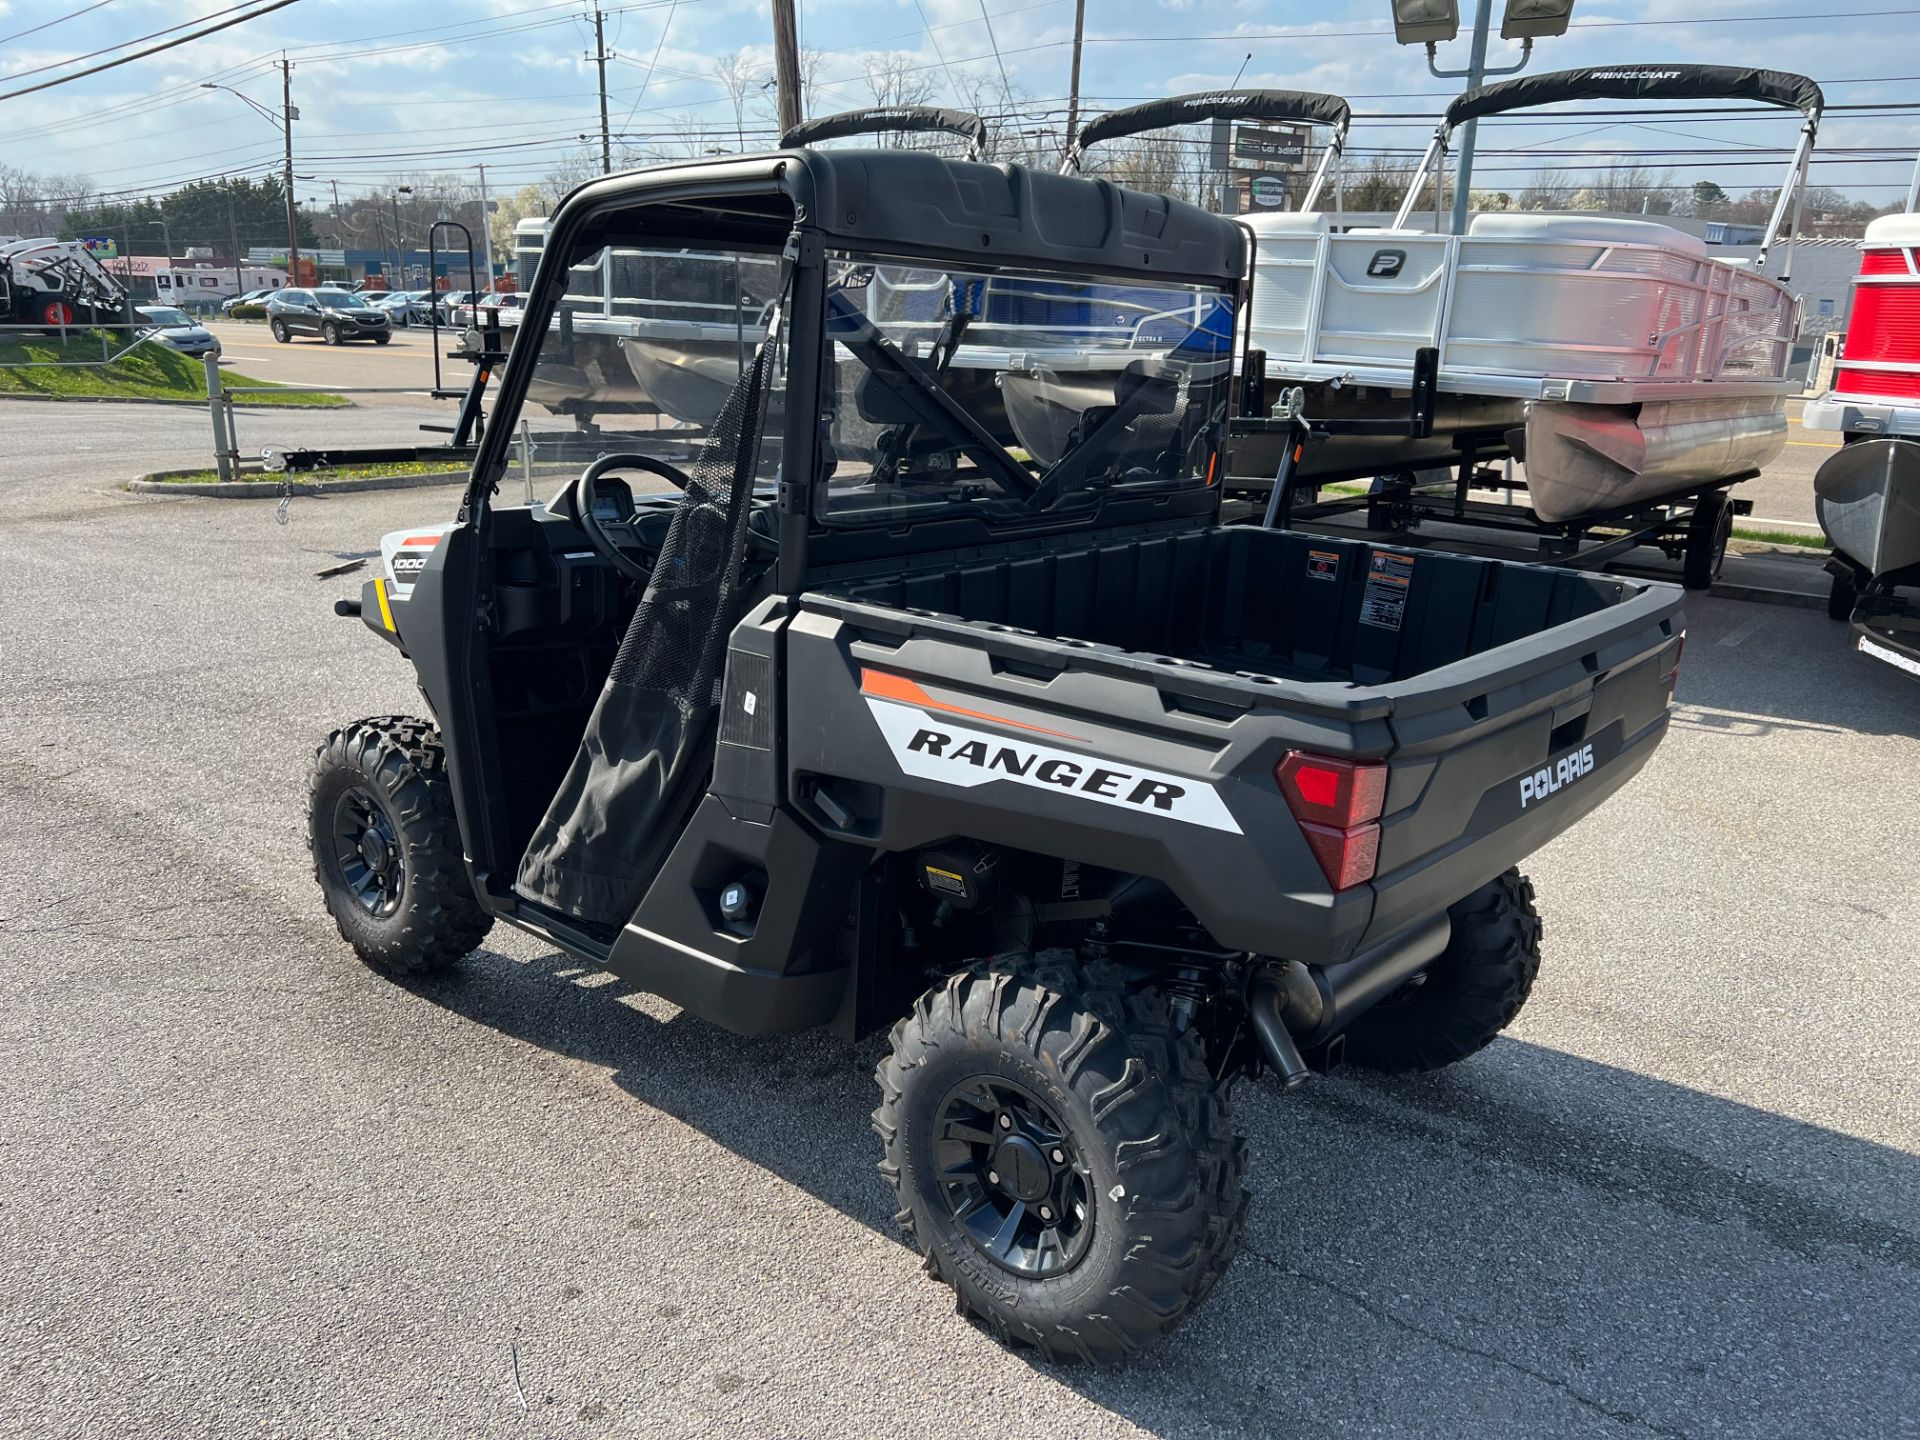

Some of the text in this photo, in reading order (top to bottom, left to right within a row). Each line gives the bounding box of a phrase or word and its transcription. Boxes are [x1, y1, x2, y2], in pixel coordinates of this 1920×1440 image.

[1590, 71, 1682, 80] PRINCECRAFT
[1183, 96, 1248, 108] PRINCECRAFT
[1277, 140, 1302, 155] Sales
[906, 728, 1186, 812] RANGER
[1520, 743, 1594, 809] POLARIS
